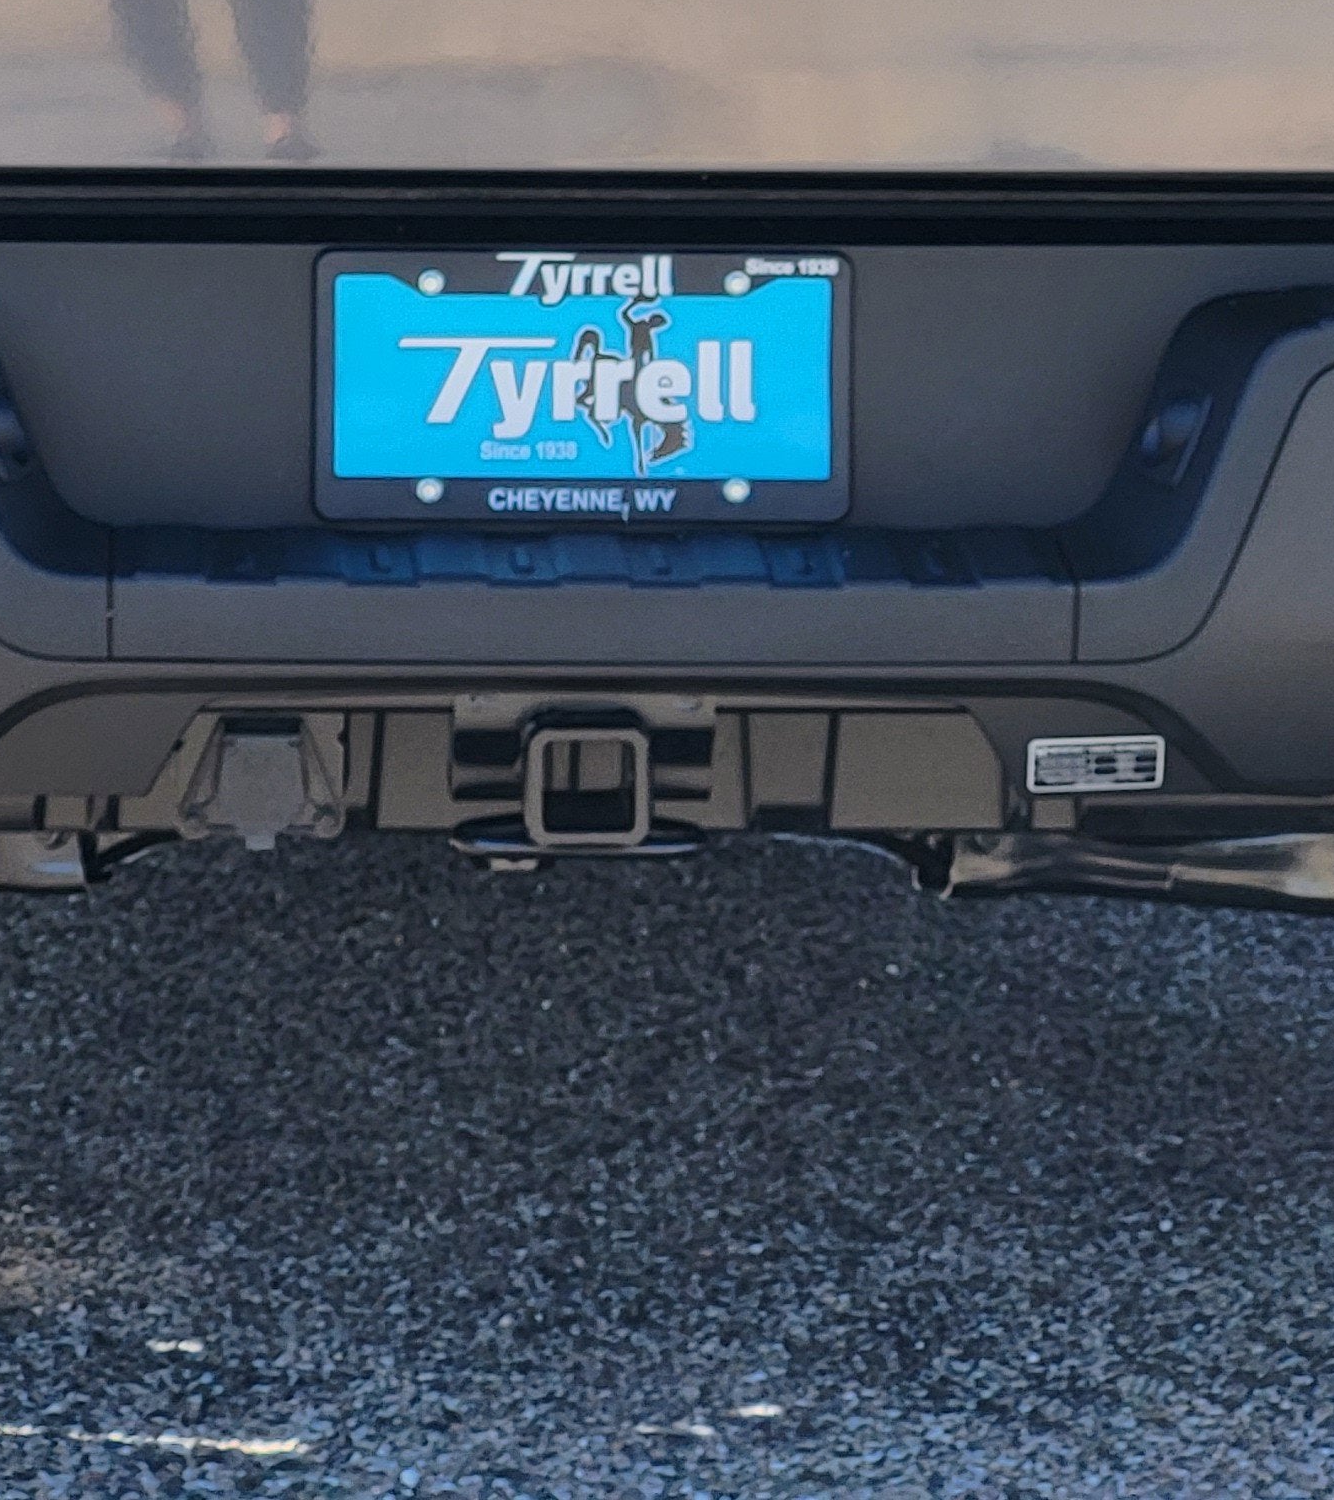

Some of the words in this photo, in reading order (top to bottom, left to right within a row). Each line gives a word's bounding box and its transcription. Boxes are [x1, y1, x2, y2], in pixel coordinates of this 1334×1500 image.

[495, 253, 673, 305] Tyrrell
[398, 337, 756, 439] Tyrrell
[488, 487, 630, 522] CHEYENNE,
[633, 488, 677, 512] WY
